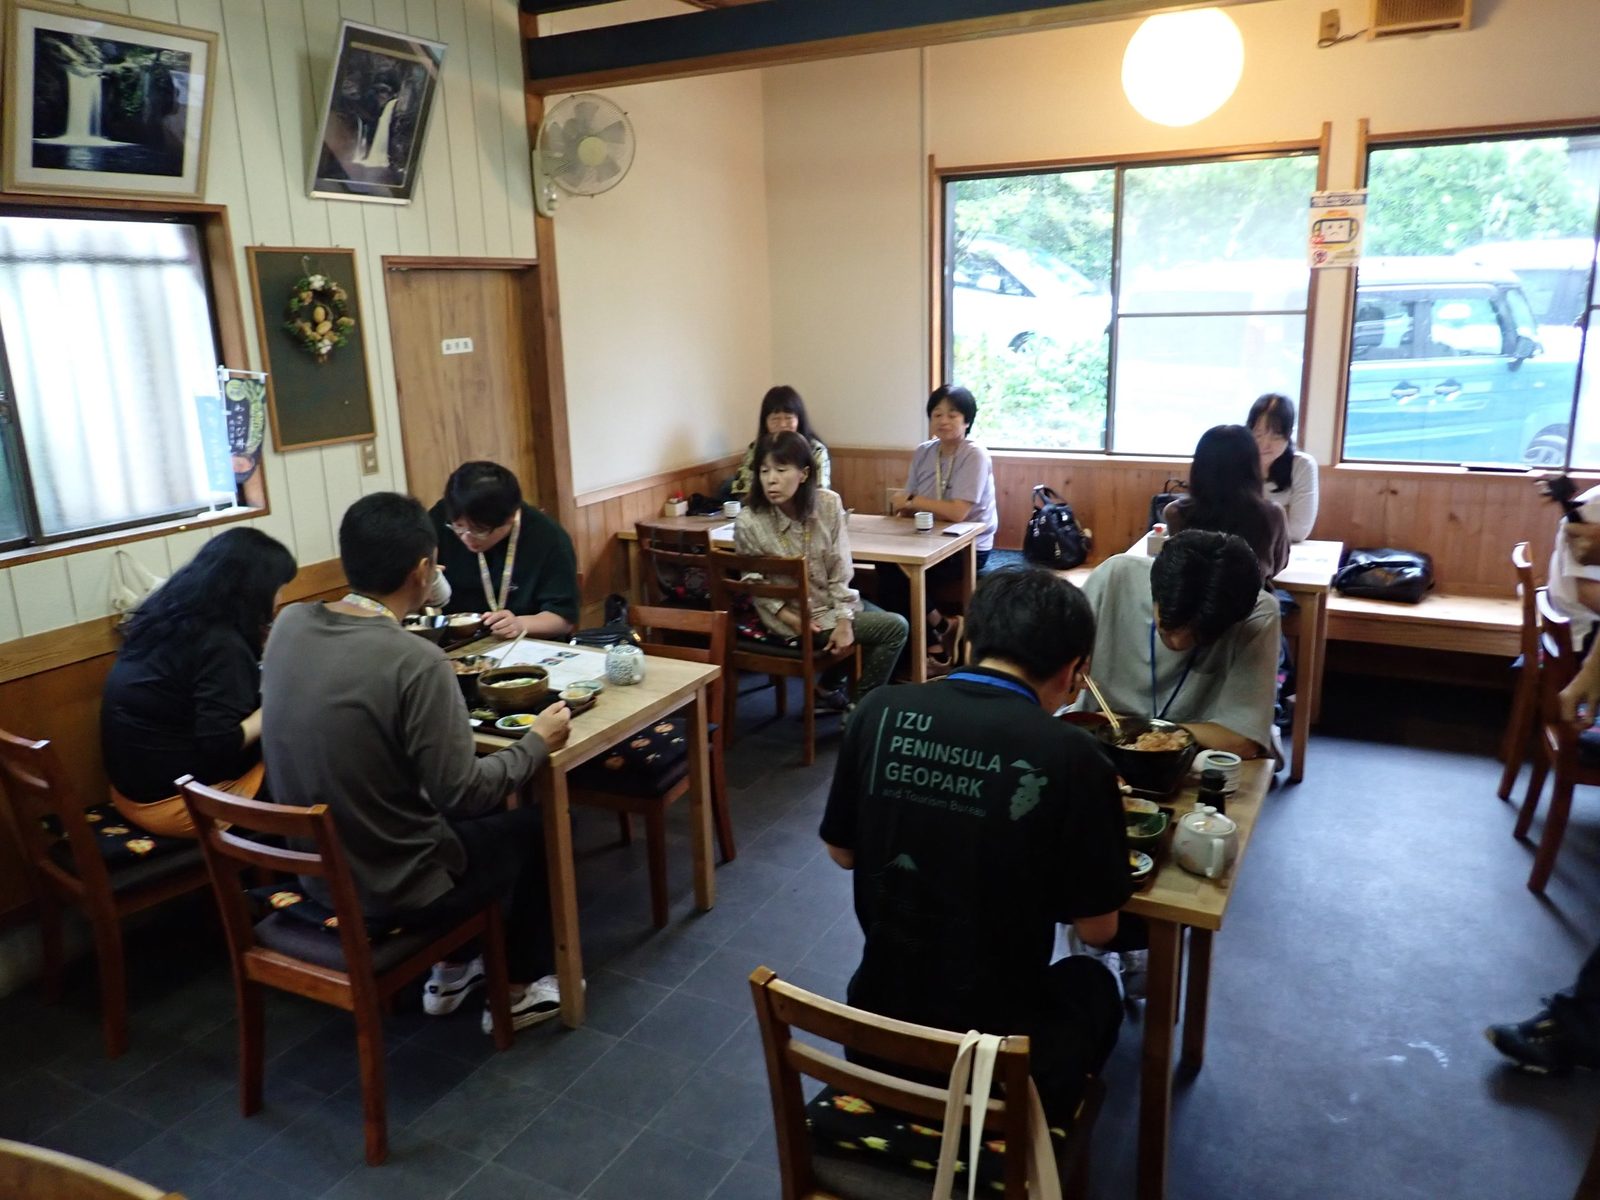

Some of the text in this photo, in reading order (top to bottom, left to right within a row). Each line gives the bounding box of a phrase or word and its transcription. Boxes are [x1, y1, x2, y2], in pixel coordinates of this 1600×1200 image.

[895, 711, 932, 732] IZU
[890, 735, 1001, 773] PENINSULA
[885, 761, 985, 798] GEOPARK
[949, 800, 987, 817] Bureau
